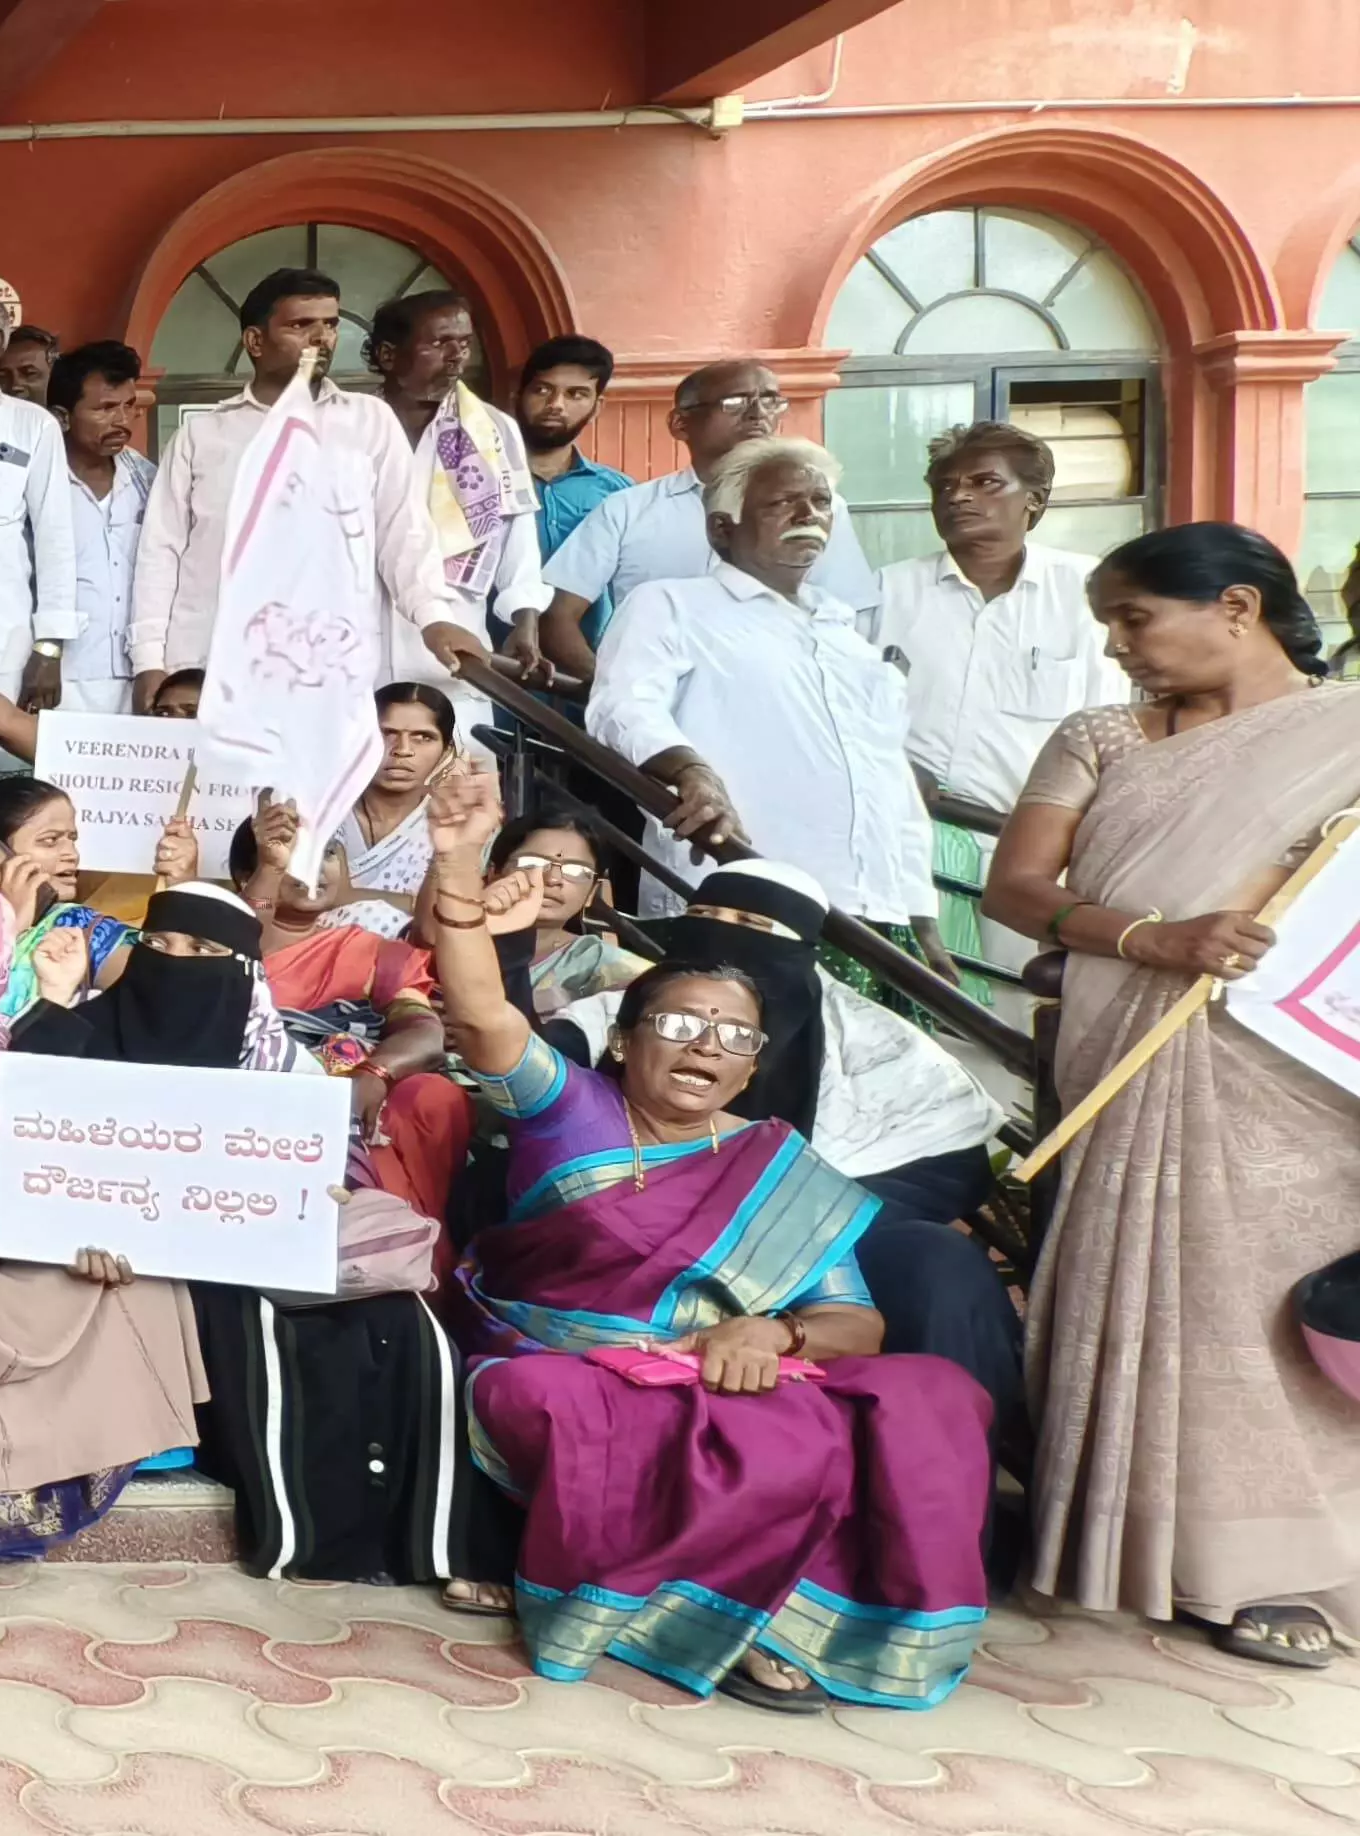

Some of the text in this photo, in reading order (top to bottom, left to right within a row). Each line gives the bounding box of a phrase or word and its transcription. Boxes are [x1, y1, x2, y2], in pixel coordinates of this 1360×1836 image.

[64, 739, 180, 761] VEERENDRA
[48, 773, 124, 791] SHOULD
[81, 808, 139, 825] RAJYA
[13, 1109, 325, 1163] ಮಹಿಳೆಯರ ಮೇಲೆ
[22, 1163, 161, 1223] ದೌರ್ಜನ್ಯ
[181, 1182, 278, 1225] ನಿಲ್ಲಲಿ
